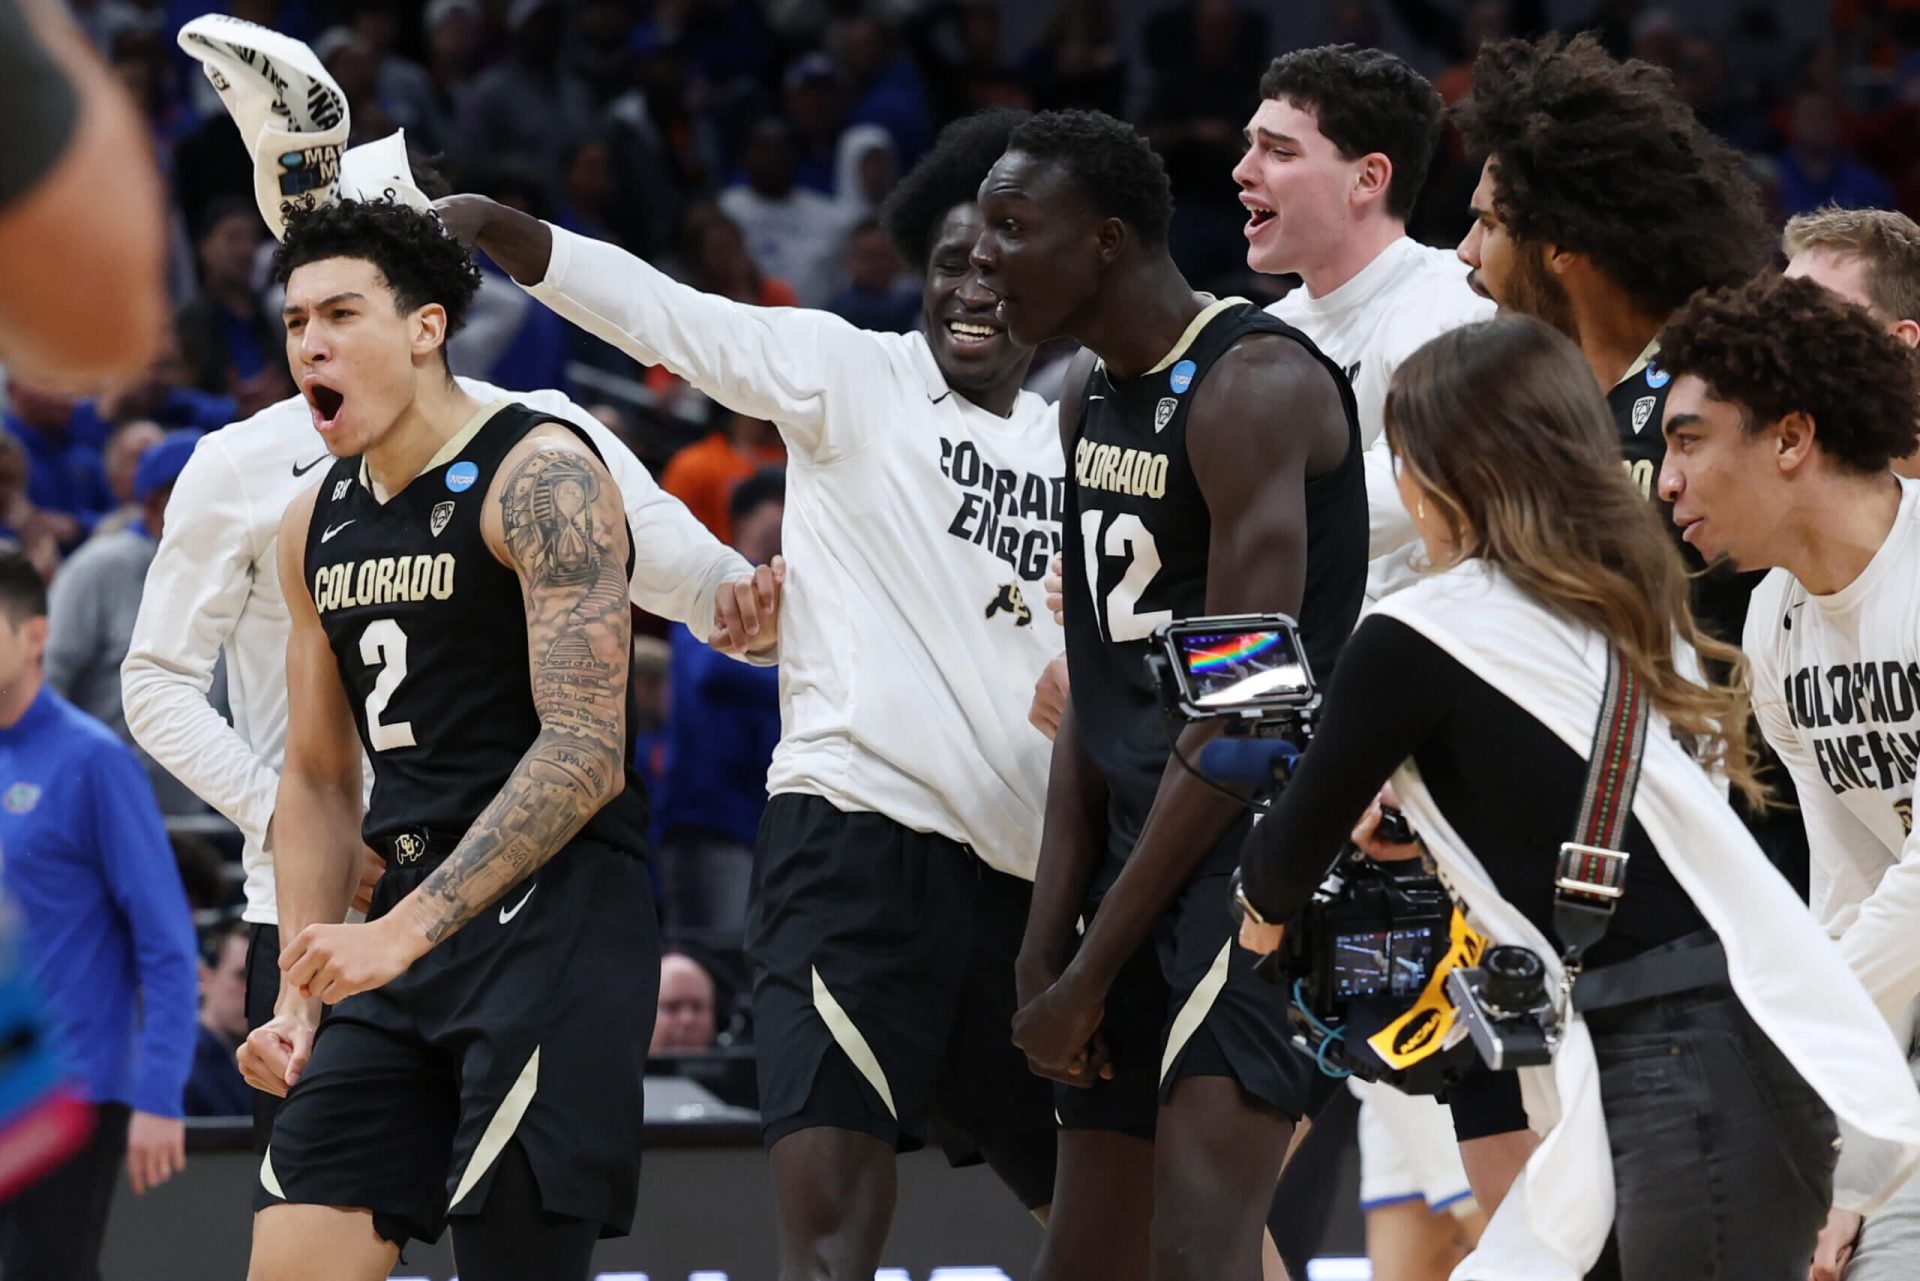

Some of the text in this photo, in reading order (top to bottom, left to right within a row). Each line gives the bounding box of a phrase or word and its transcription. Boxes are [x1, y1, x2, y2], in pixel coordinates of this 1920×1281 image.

[433, 516, 445, 529] 12
[315, 553, 456, 614] COLORADO
[1080, 509, 1173, 643] 12
[359, 618, 418, 752] 2
